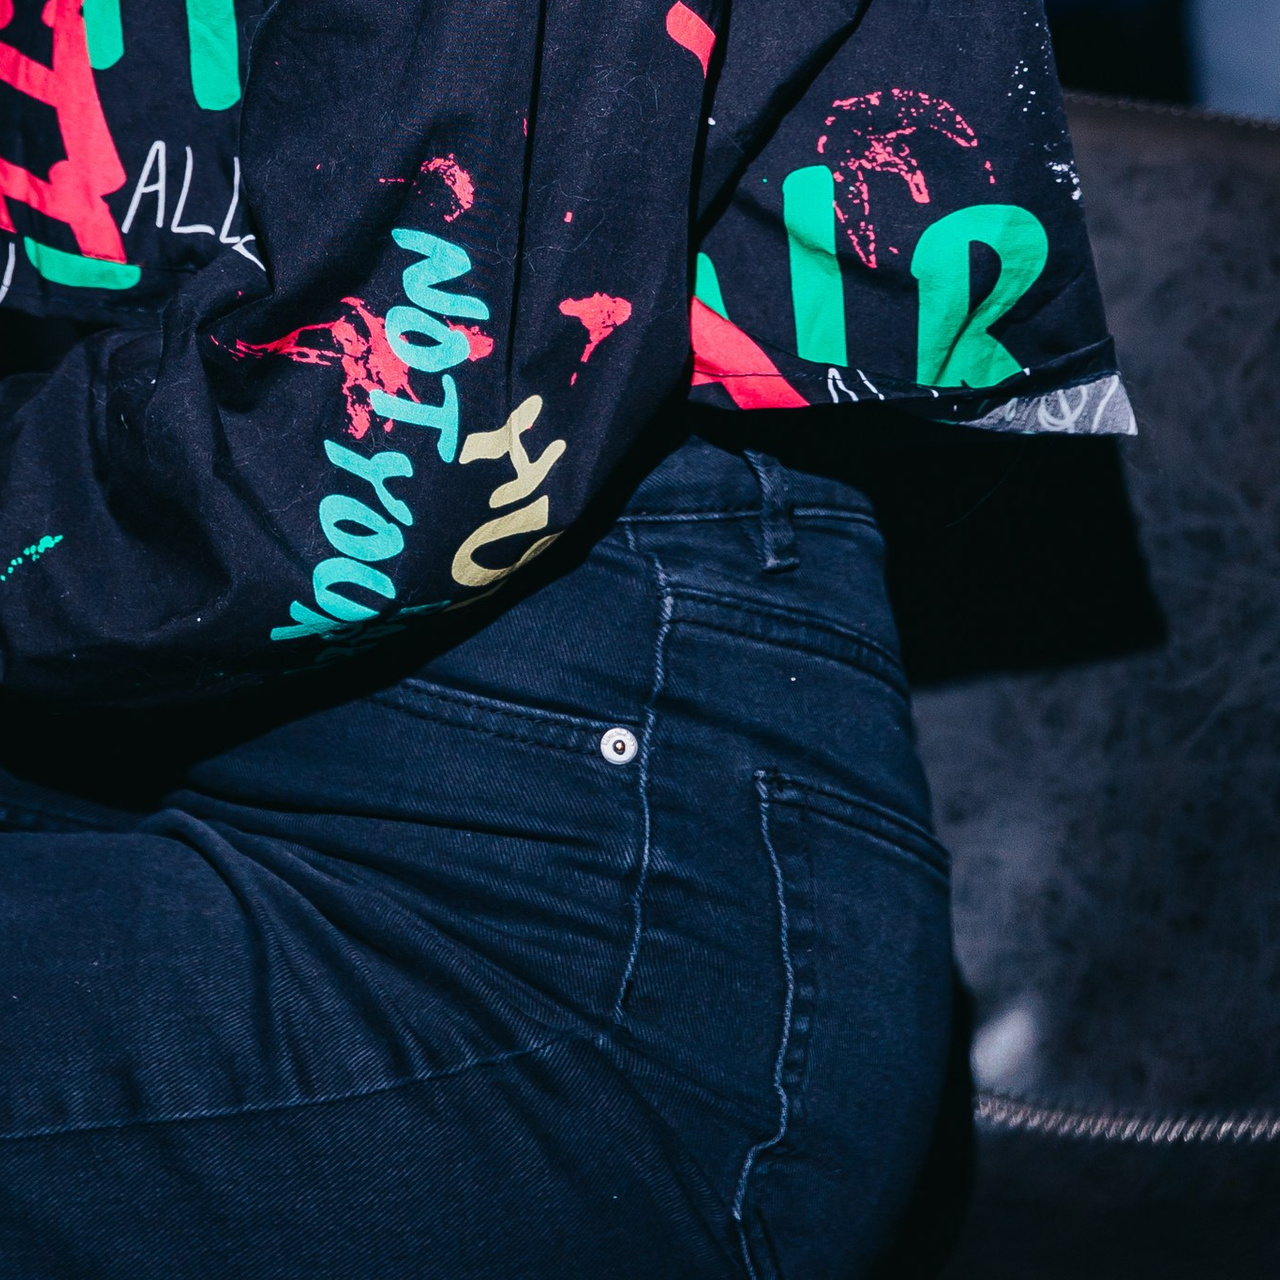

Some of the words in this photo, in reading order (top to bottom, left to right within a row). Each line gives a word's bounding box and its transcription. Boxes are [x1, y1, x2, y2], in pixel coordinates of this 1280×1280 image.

[121, 141, 248, 250] ALL
[370, 227, 490, 464] NOT
[451, 395, 567, 587] HU
